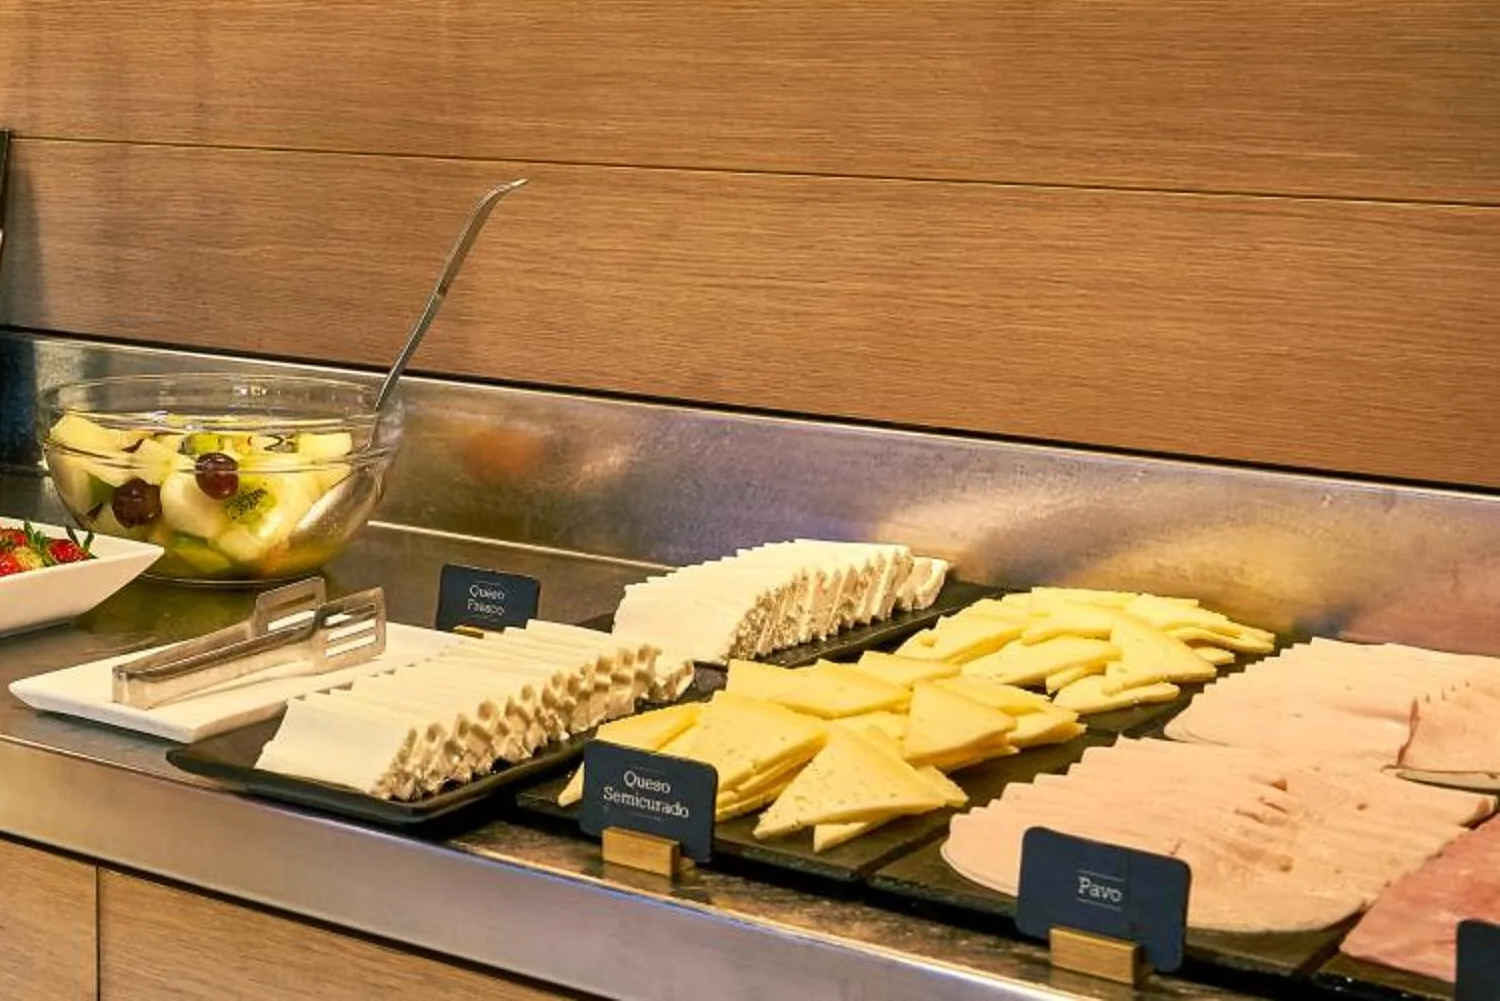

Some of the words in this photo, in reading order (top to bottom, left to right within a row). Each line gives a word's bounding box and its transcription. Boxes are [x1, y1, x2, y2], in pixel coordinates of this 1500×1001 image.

[469, 584, 506, 600] Queso
[467, 599, 506, 616] Fresco
[623, 770, 671, 794] Queso
[603, 786, 689, 819] Semicurado
[1077, 876, 1123, 903] Pavo
